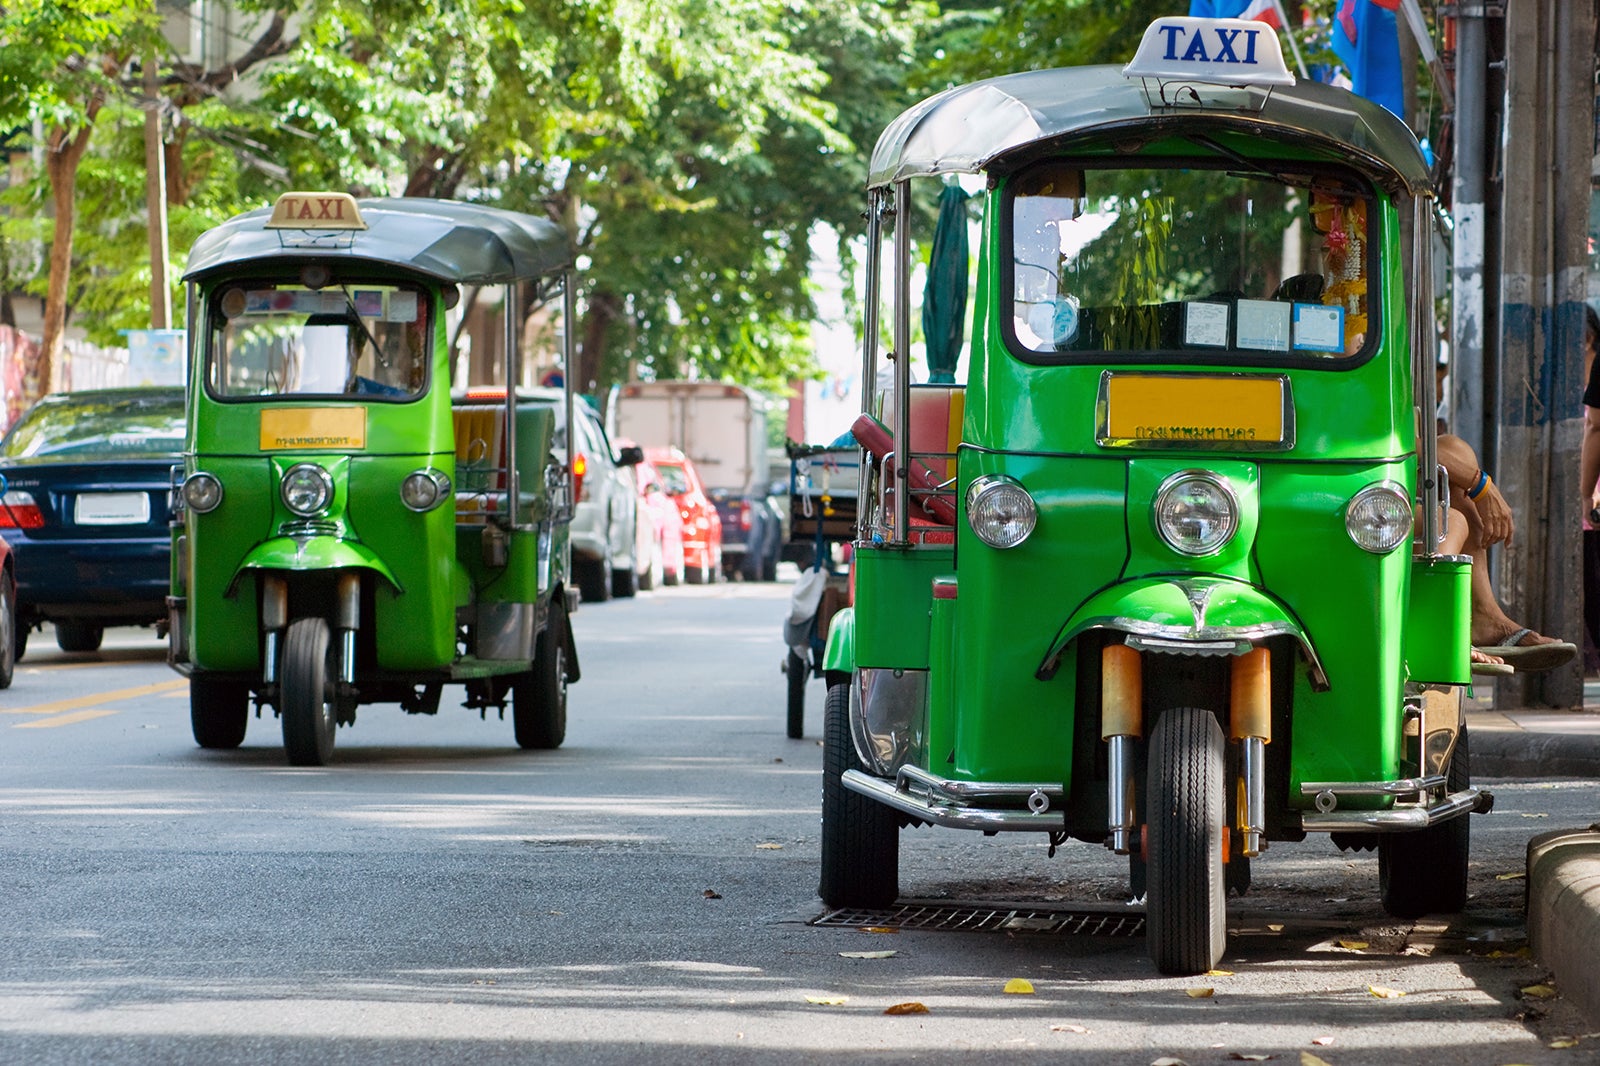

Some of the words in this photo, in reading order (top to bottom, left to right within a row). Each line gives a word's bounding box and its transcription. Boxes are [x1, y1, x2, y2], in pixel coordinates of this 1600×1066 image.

[1158, 25, 1261, 64] TAXI
[281, 198, 345, 220] TAXI
[1135, 425, 1257, 440] กรงเทพมหานคร
